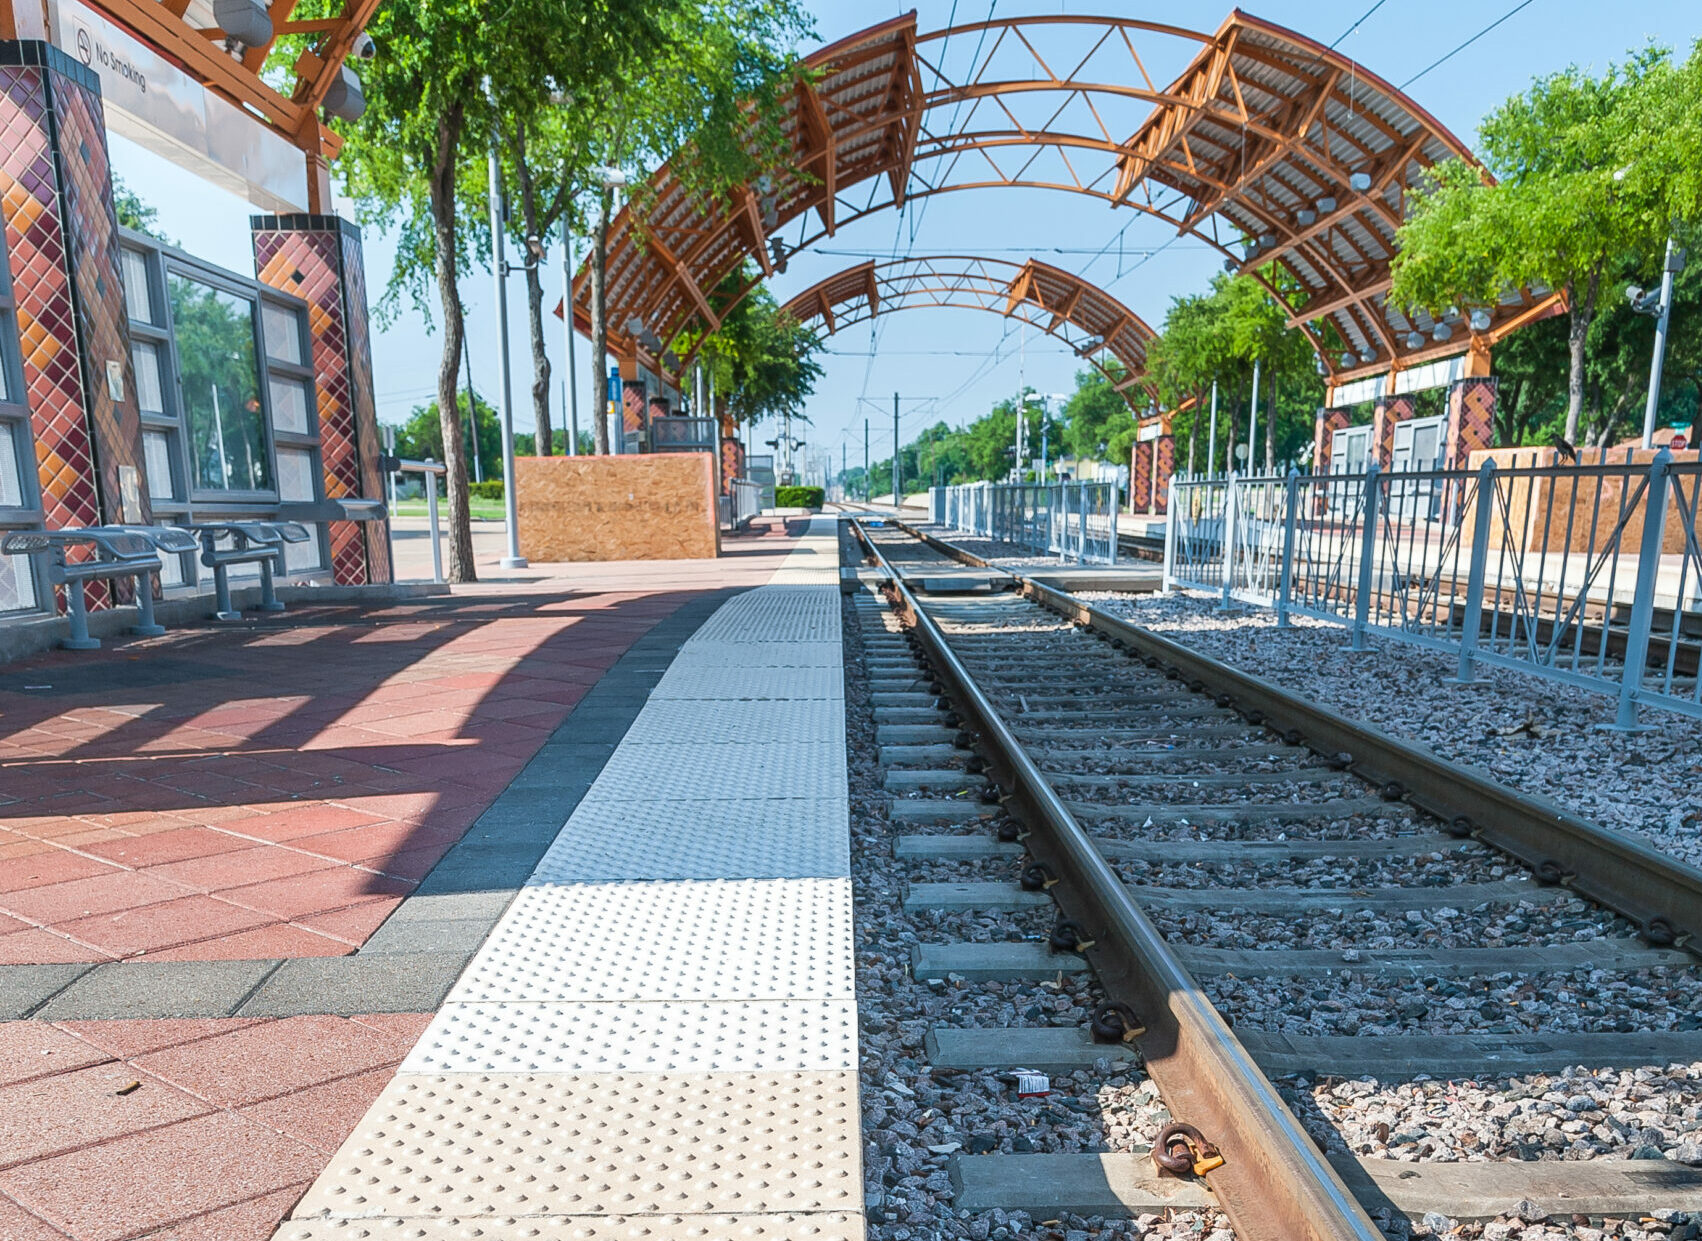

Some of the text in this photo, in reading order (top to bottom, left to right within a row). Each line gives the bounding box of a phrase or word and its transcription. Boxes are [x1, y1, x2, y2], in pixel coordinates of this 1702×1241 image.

[95, 42, 146, 94] No Smoking
[1671, 439, 1686, 447] STOP
